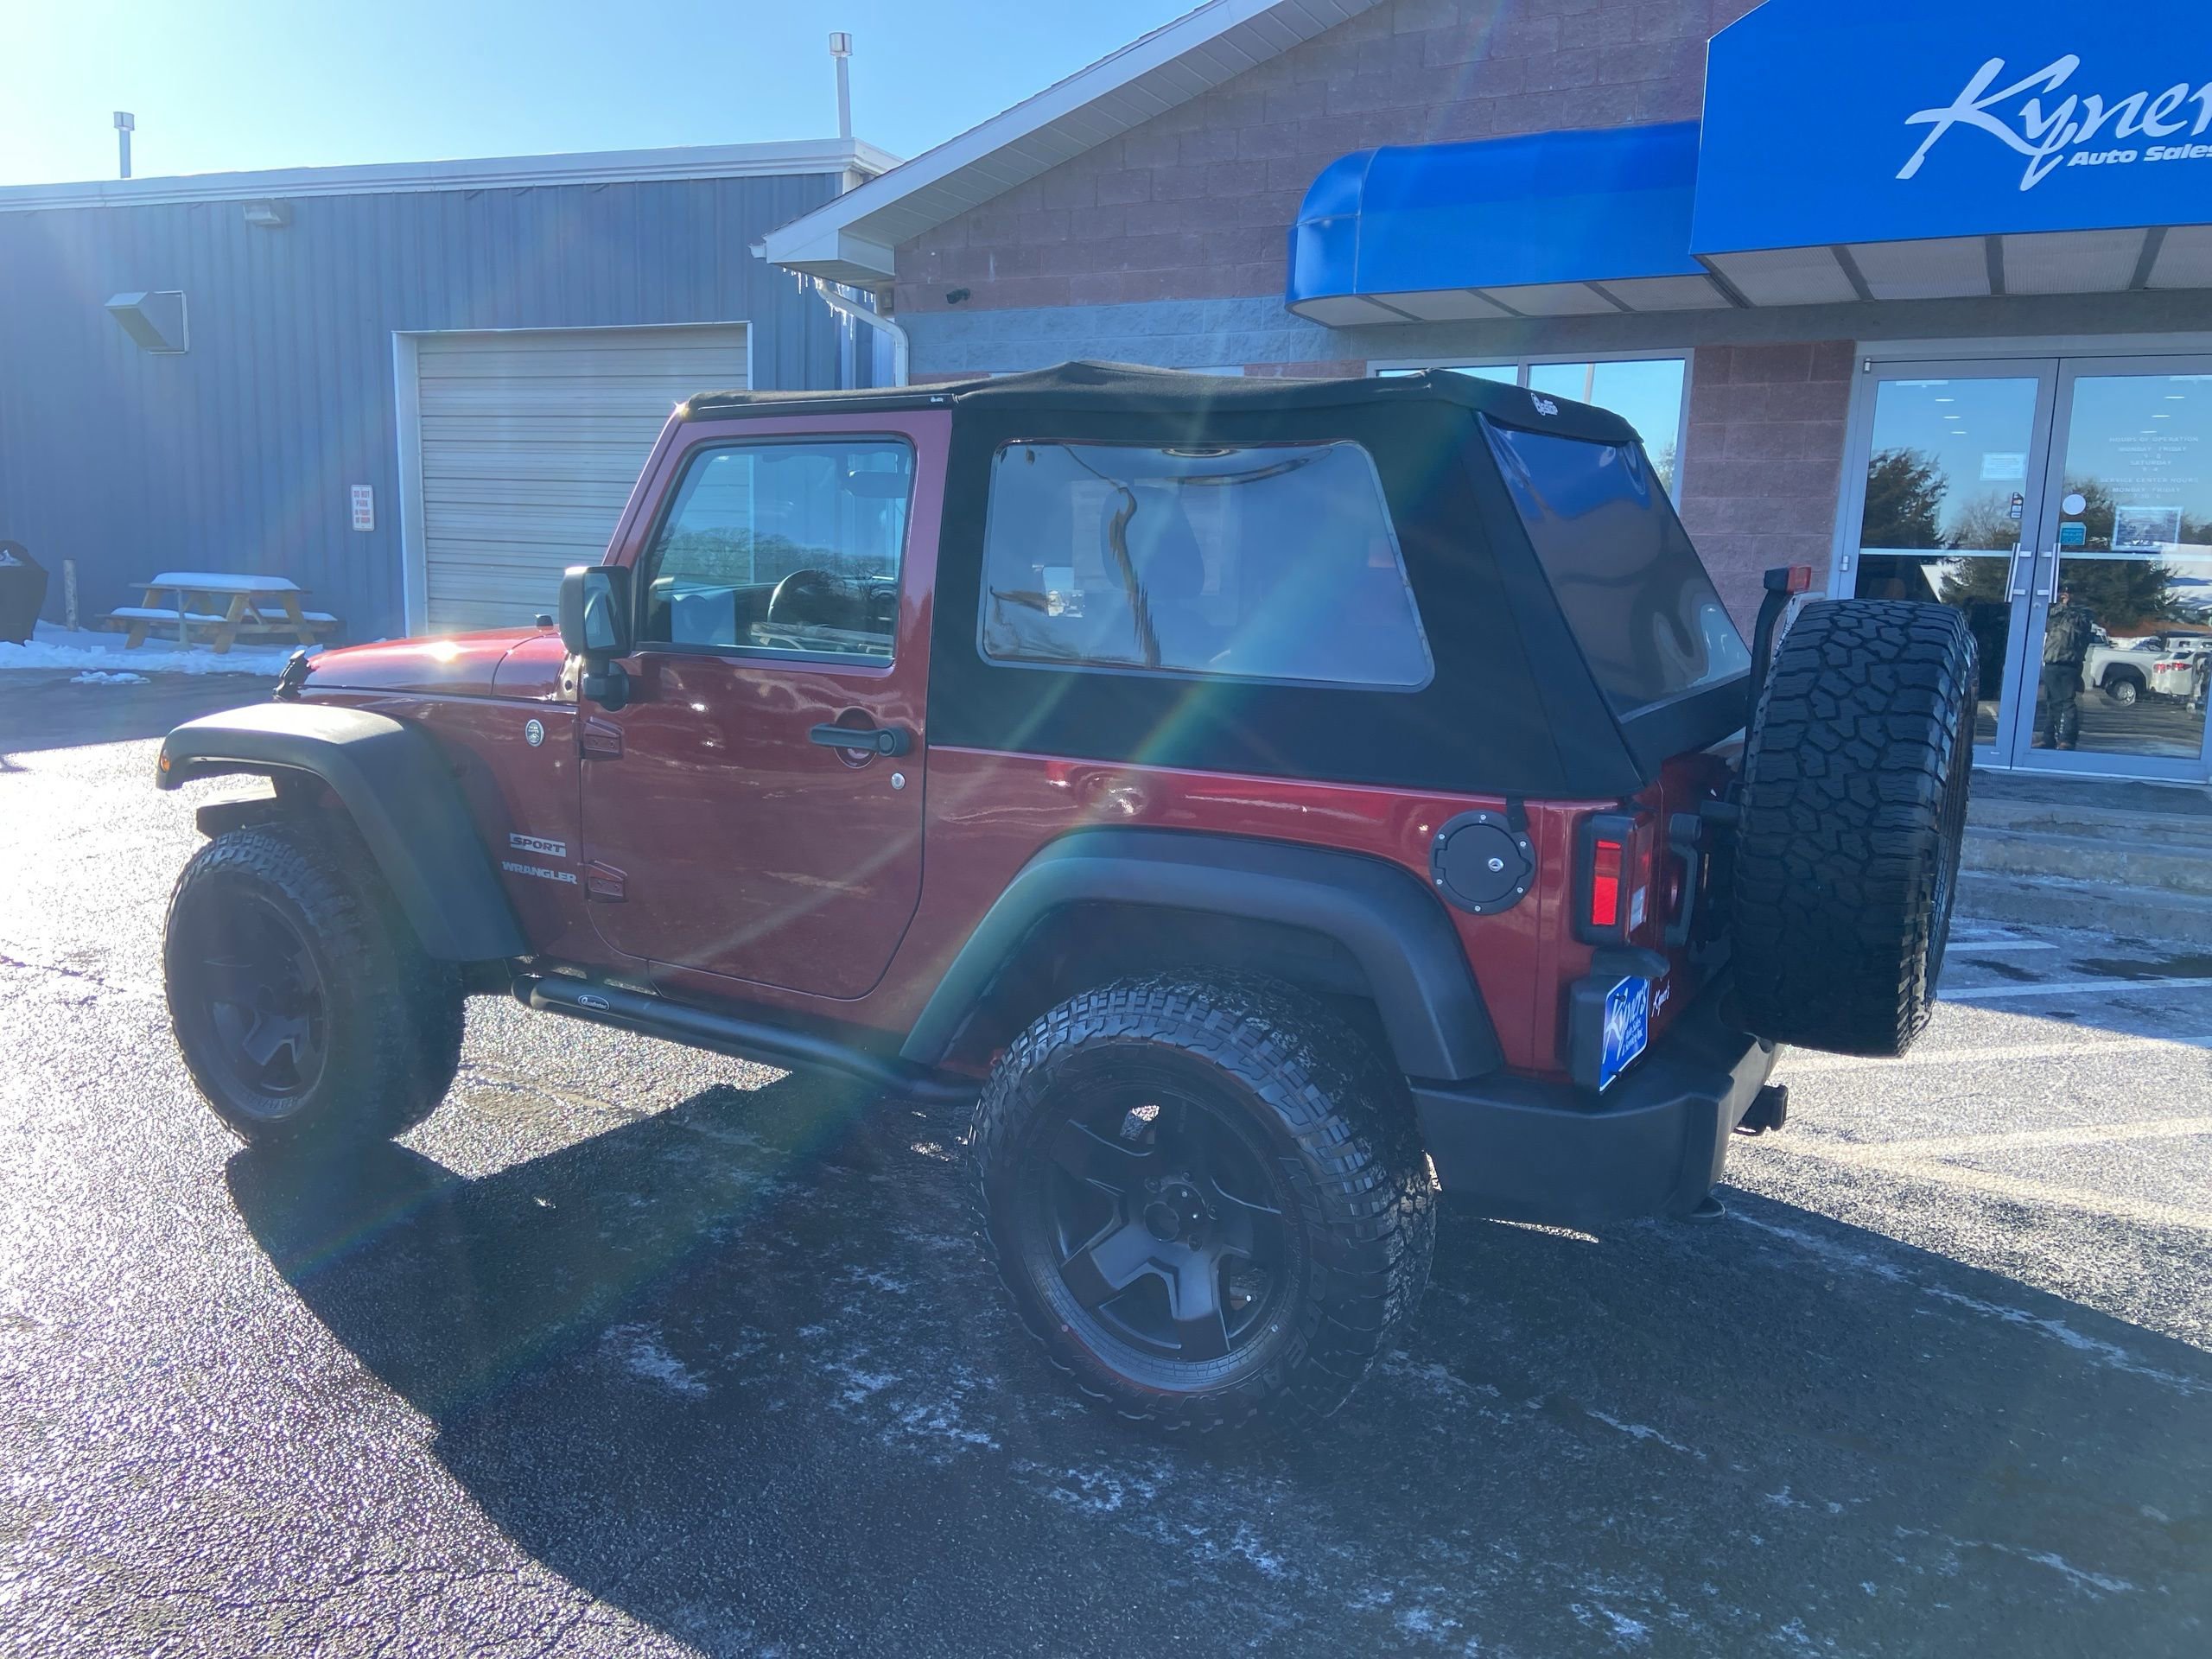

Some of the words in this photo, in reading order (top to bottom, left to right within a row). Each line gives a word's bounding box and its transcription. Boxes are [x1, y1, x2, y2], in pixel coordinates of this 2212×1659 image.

[2067, 148, 2138, 167] Auto
[511, 835, 566, 855] SPORT
[502, 861, 578, 885] WRANGLER
